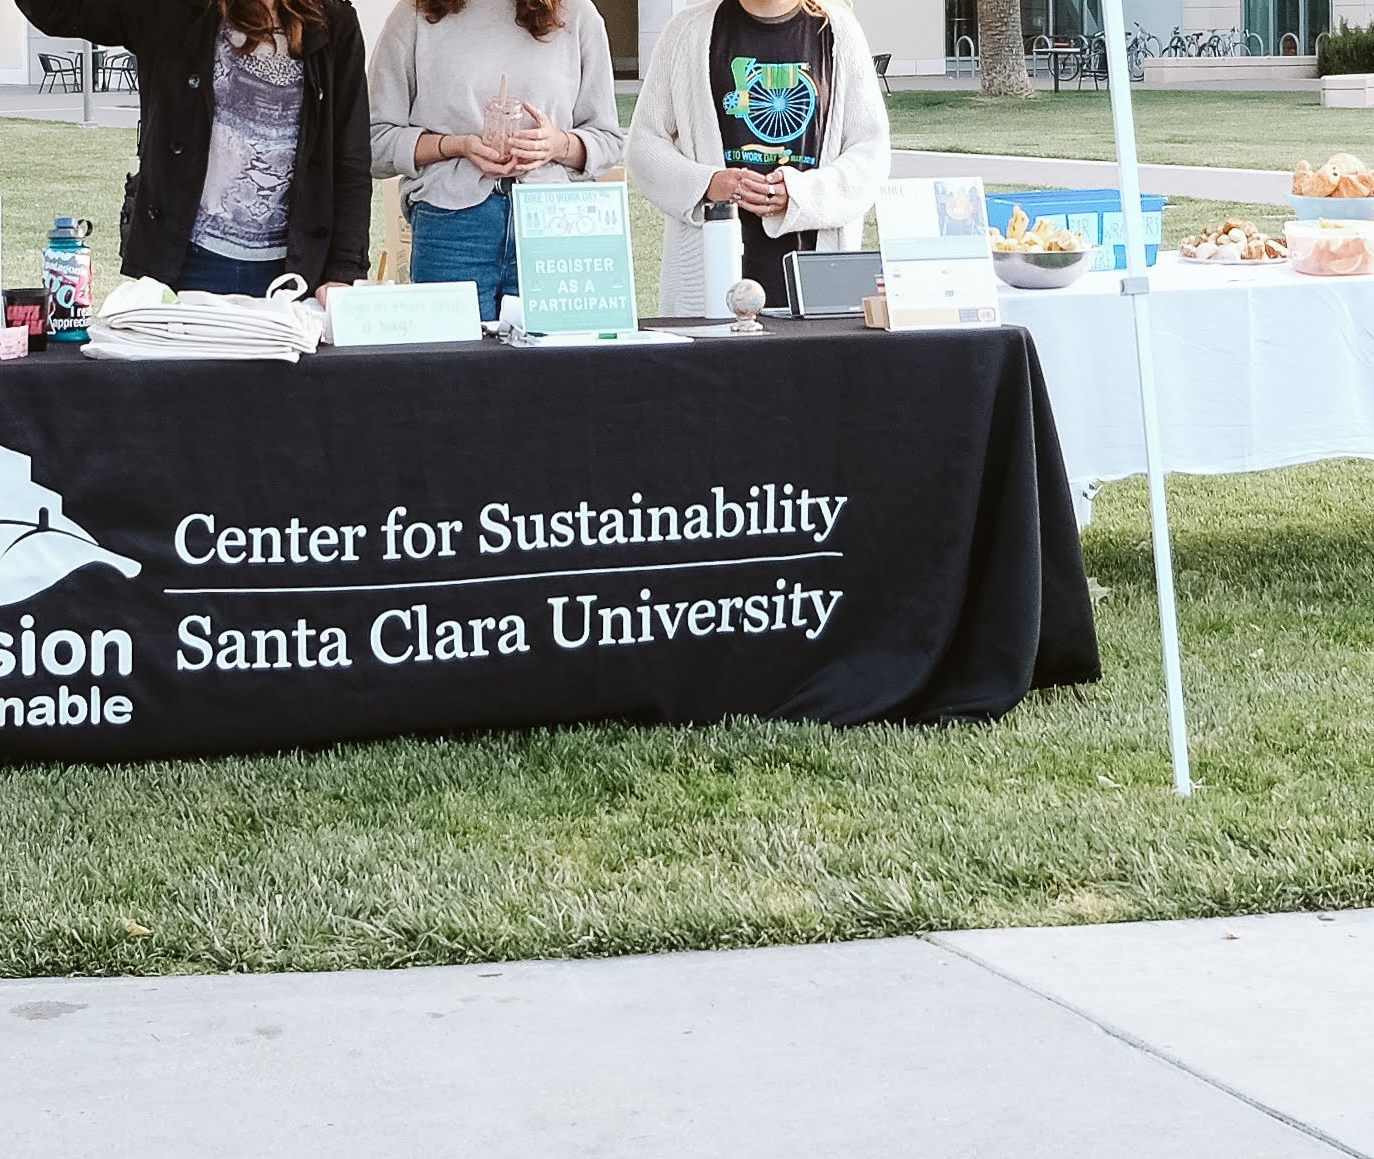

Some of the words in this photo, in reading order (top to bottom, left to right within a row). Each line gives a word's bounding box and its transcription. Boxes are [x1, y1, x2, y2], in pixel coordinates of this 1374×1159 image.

[732, 149, 741, 160] TO
[742, 150, 763, 163] WORK
[764, 153, 777, 163] DAY
[582, 190, 598, 201] DAY
[535, 257, 615, 274] REGISTER
[557, 279, 579, 294] AS
[585, 279, 595, 293] A
[528, 295, 627, 312] PARTICIPANT
[174, 513, 367, 565] Center
[380, 506, 463, 561] for
[478, 483, 848, 554] Sustainability
[177, 614, 353, 671] Santa
[370, 604, 531, 665] Clara
[547, 578, 843, 650] University
